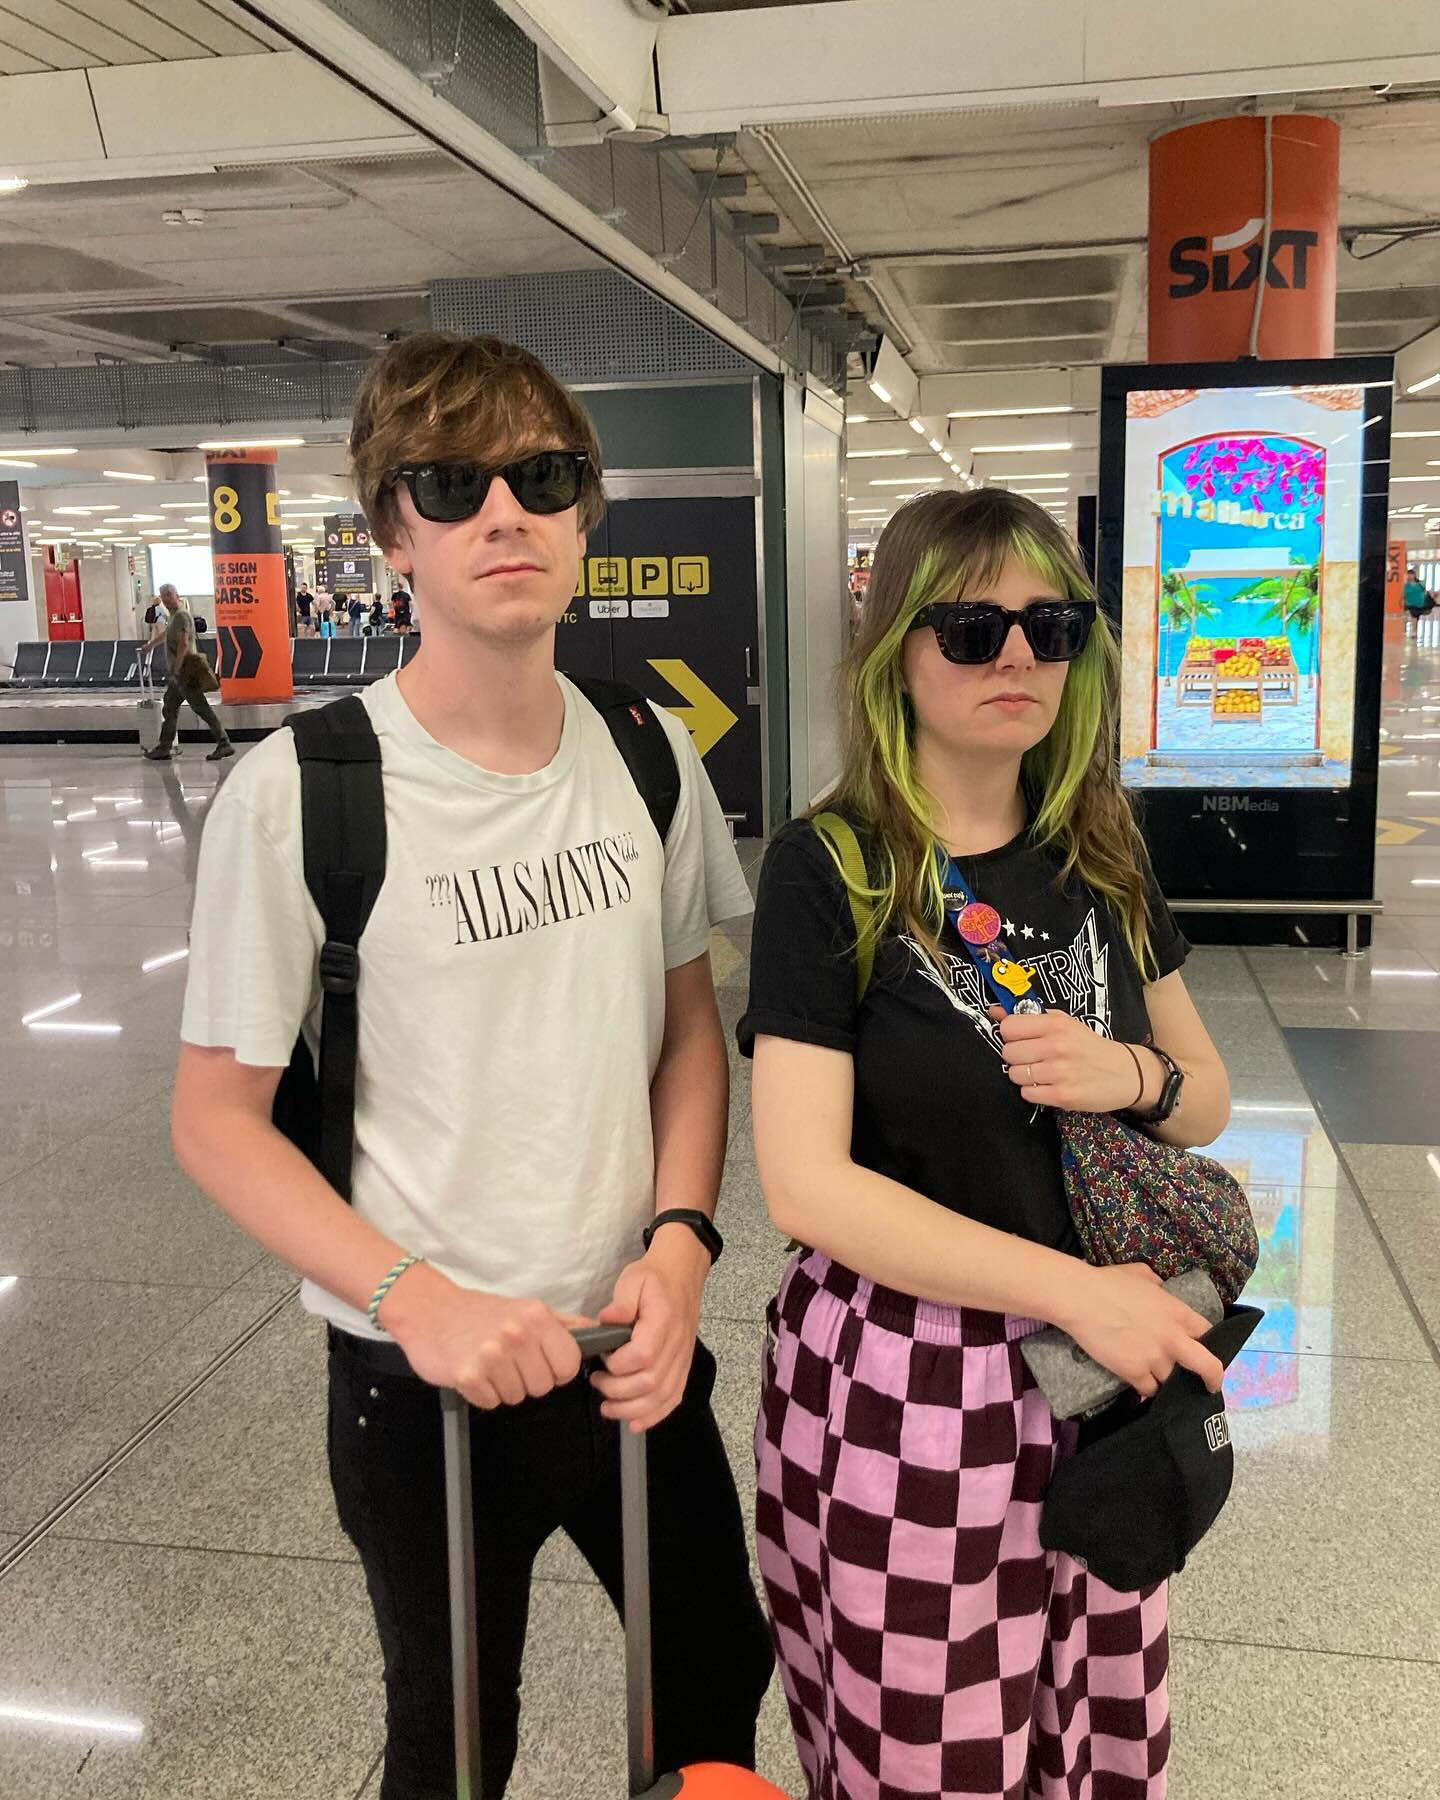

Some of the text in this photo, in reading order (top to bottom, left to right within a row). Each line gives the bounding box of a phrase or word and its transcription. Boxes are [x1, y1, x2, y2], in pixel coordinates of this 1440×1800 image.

[1168, 218, 1318, 299] SIXT
[213, 485, 241, 533] 8
[228, 562, 257, 574] SIGN
[641, 563, 660, 590] P
[226, 576, 258, 585] GREAT
[597, 604, 621, 614] Uber
